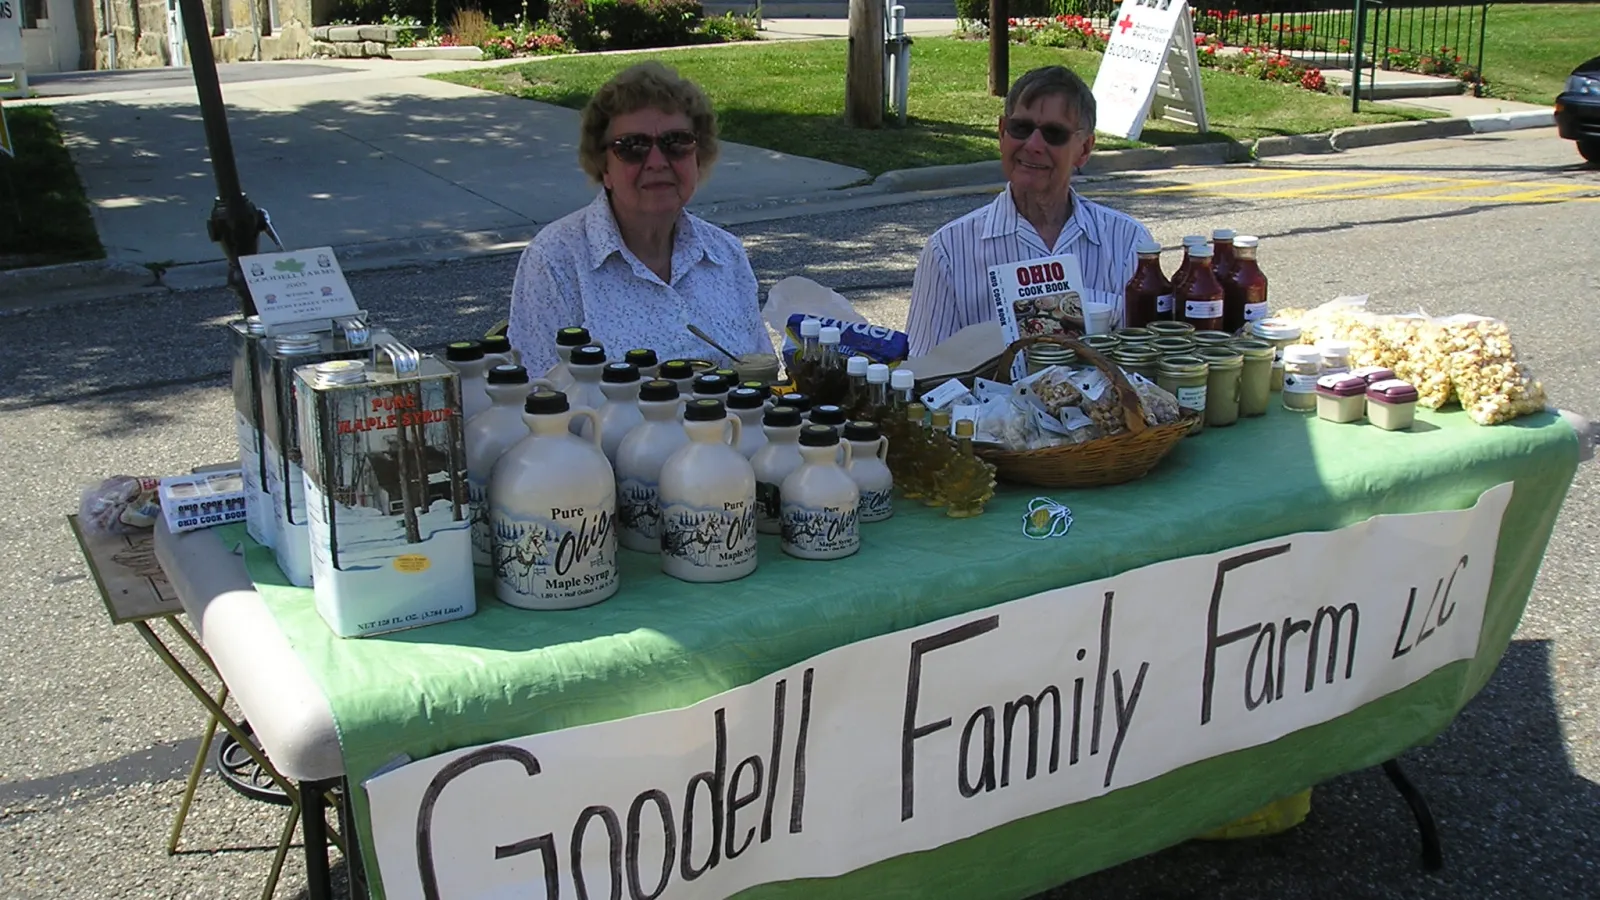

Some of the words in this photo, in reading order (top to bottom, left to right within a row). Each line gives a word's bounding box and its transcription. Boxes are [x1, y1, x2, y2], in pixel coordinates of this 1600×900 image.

[300, 269, 336, 278] FARMS
[989, 271, 998, 288] OHIO
[1016, 261, 1065, 286] OHIO
[993, 288, 1003, 307] COOK
[1018, 285, 1044, 297] COOK
[1045, 281, 1071, 293] BOOK
[996, 307, 1007, 327] BOOK
[372, 394, 416, 412] PURE
[337, 417, 399, 435] MAPLE
[402, 408, 454, 427] SYRUP
[178, 503, 199, 513] OHIO
[200, 499, 223, 509] COOK
[551, 507, 584, 520] Pure
[724, 501, 744, 511] Pure
[178, 518, 199, 528] OHIO
[200, 515, 223, 525] COOK
[555, 511, 614, 576] Ohio
[719, 549, 743, 561] Maple
[545, 578, 581, 591] Maple
[584, 569, 610, 587] Syrup
[357, 621, 376, 631] NET
[378, 619, 390, 627] 128
[416, 667, 814, 900] Goodell
[901, 591, 1150, 822] Family
[1200, 543, 1361, 726] Farm
[1392, 554, 1469, 660] LLC
